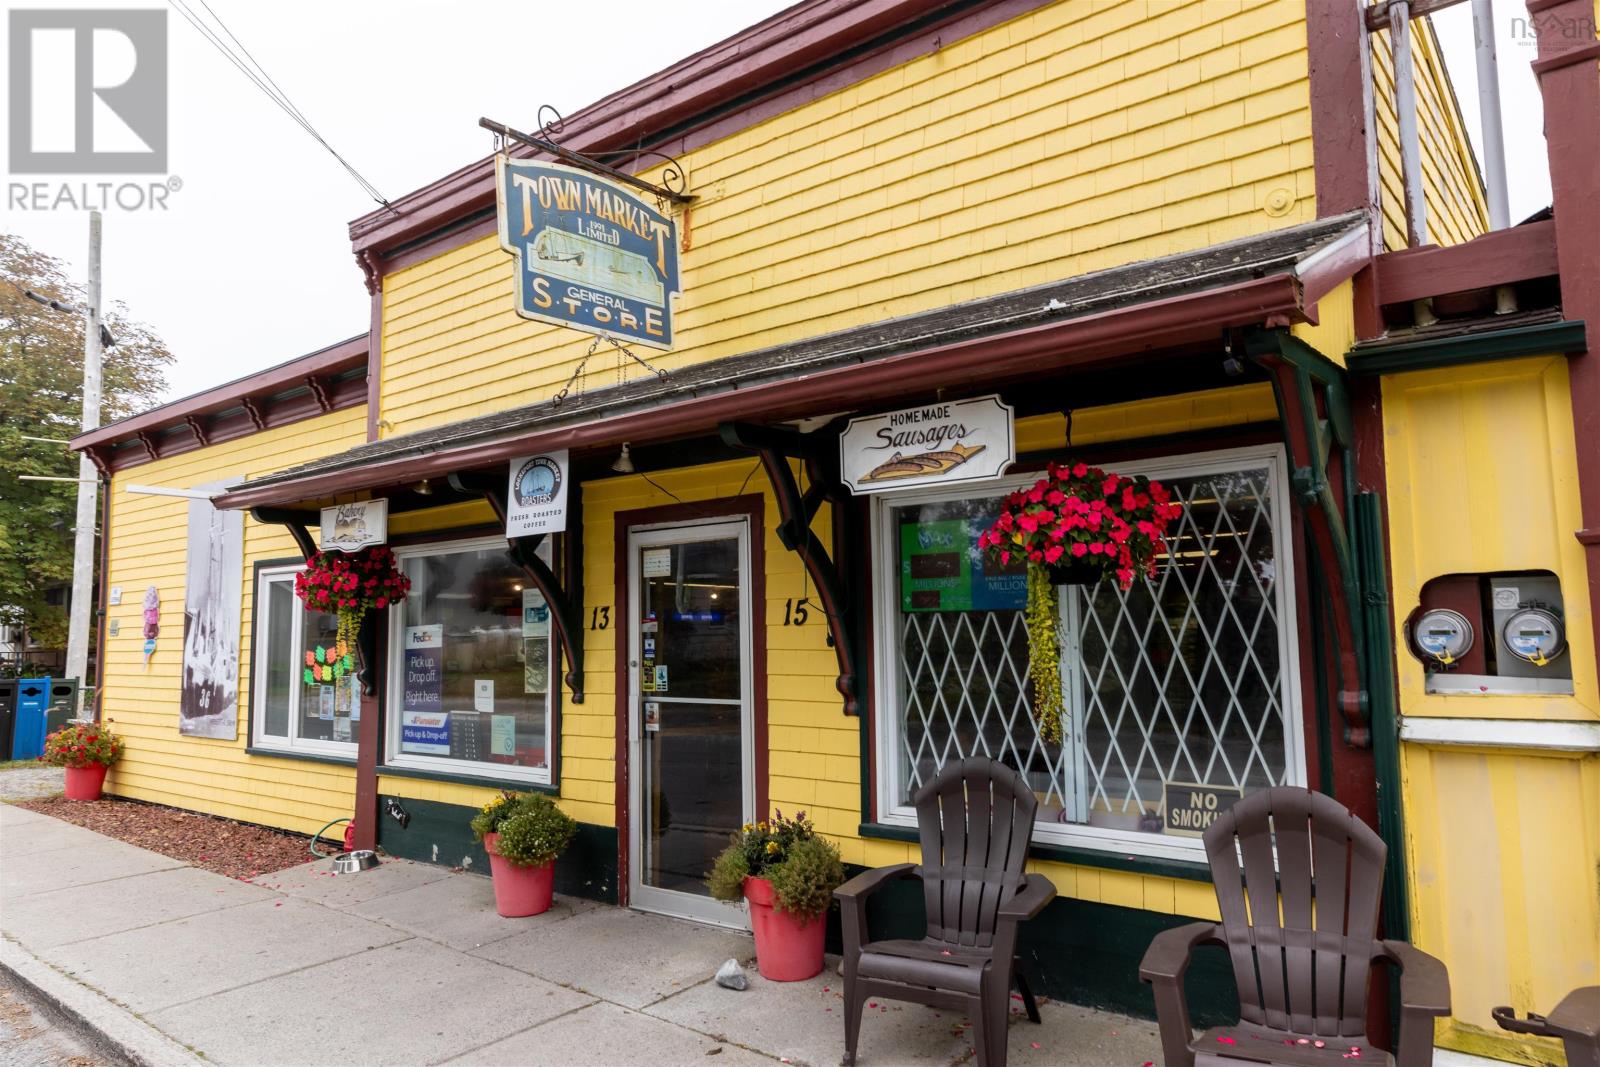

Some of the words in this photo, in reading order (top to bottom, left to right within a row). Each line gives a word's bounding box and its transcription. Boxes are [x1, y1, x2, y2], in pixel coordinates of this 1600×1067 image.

[567, 286, 630, 311] GENERAL
[866, 423, 976, 451] Sausages
[590, 606, 610, 631] 13
[783, 598, 809, 626] 15
[412, 631, 433, 644] FedEx
[408, 671, 425, 685] Drop
[1190, 791, 1218, 810] NO
